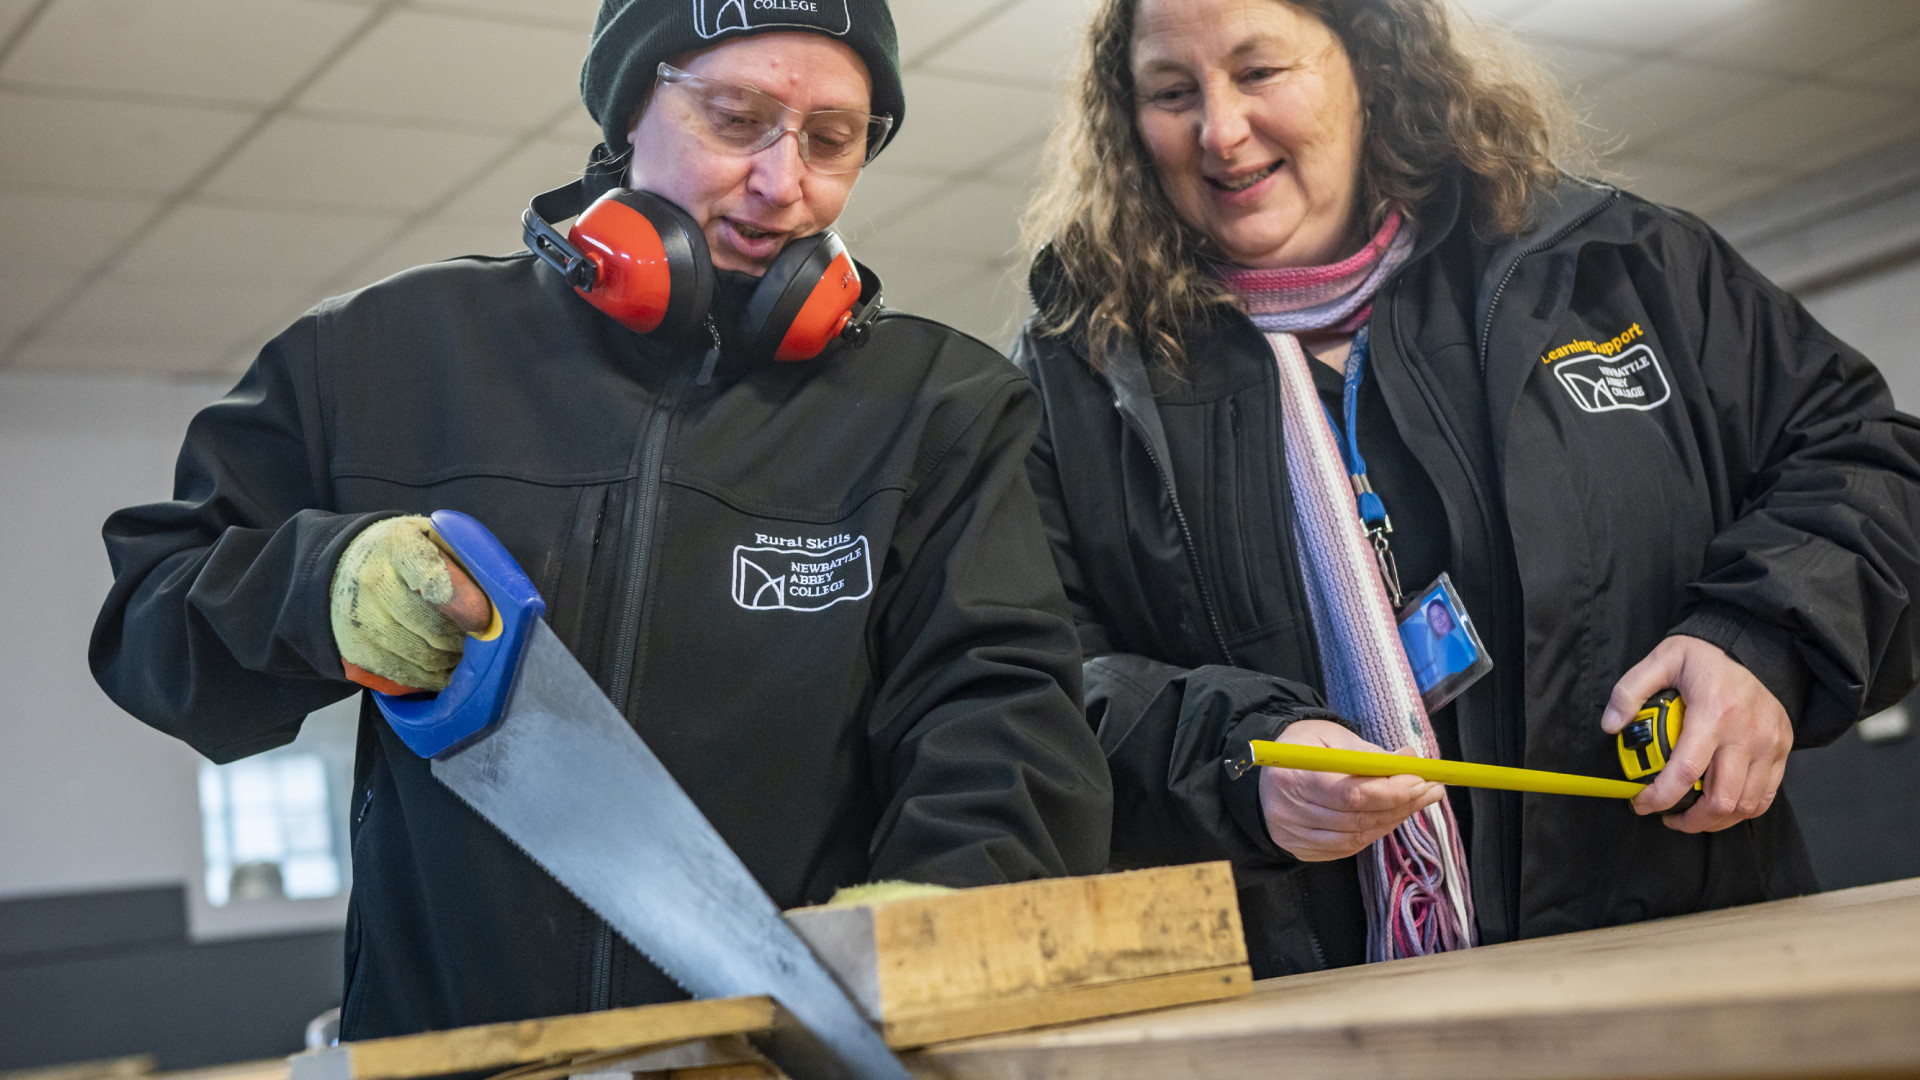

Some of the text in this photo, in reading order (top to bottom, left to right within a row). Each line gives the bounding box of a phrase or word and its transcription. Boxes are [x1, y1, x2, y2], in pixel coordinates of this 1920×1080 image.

[753, 0, 818, 12] COLLEGE
[755, 533, 851, 549] Rural Skills
[790, 547, 862, 574] NEWBATTLE
[789, 571, 834, 585] ABBEY
[789, 579, 845, 597] COLLEGE
